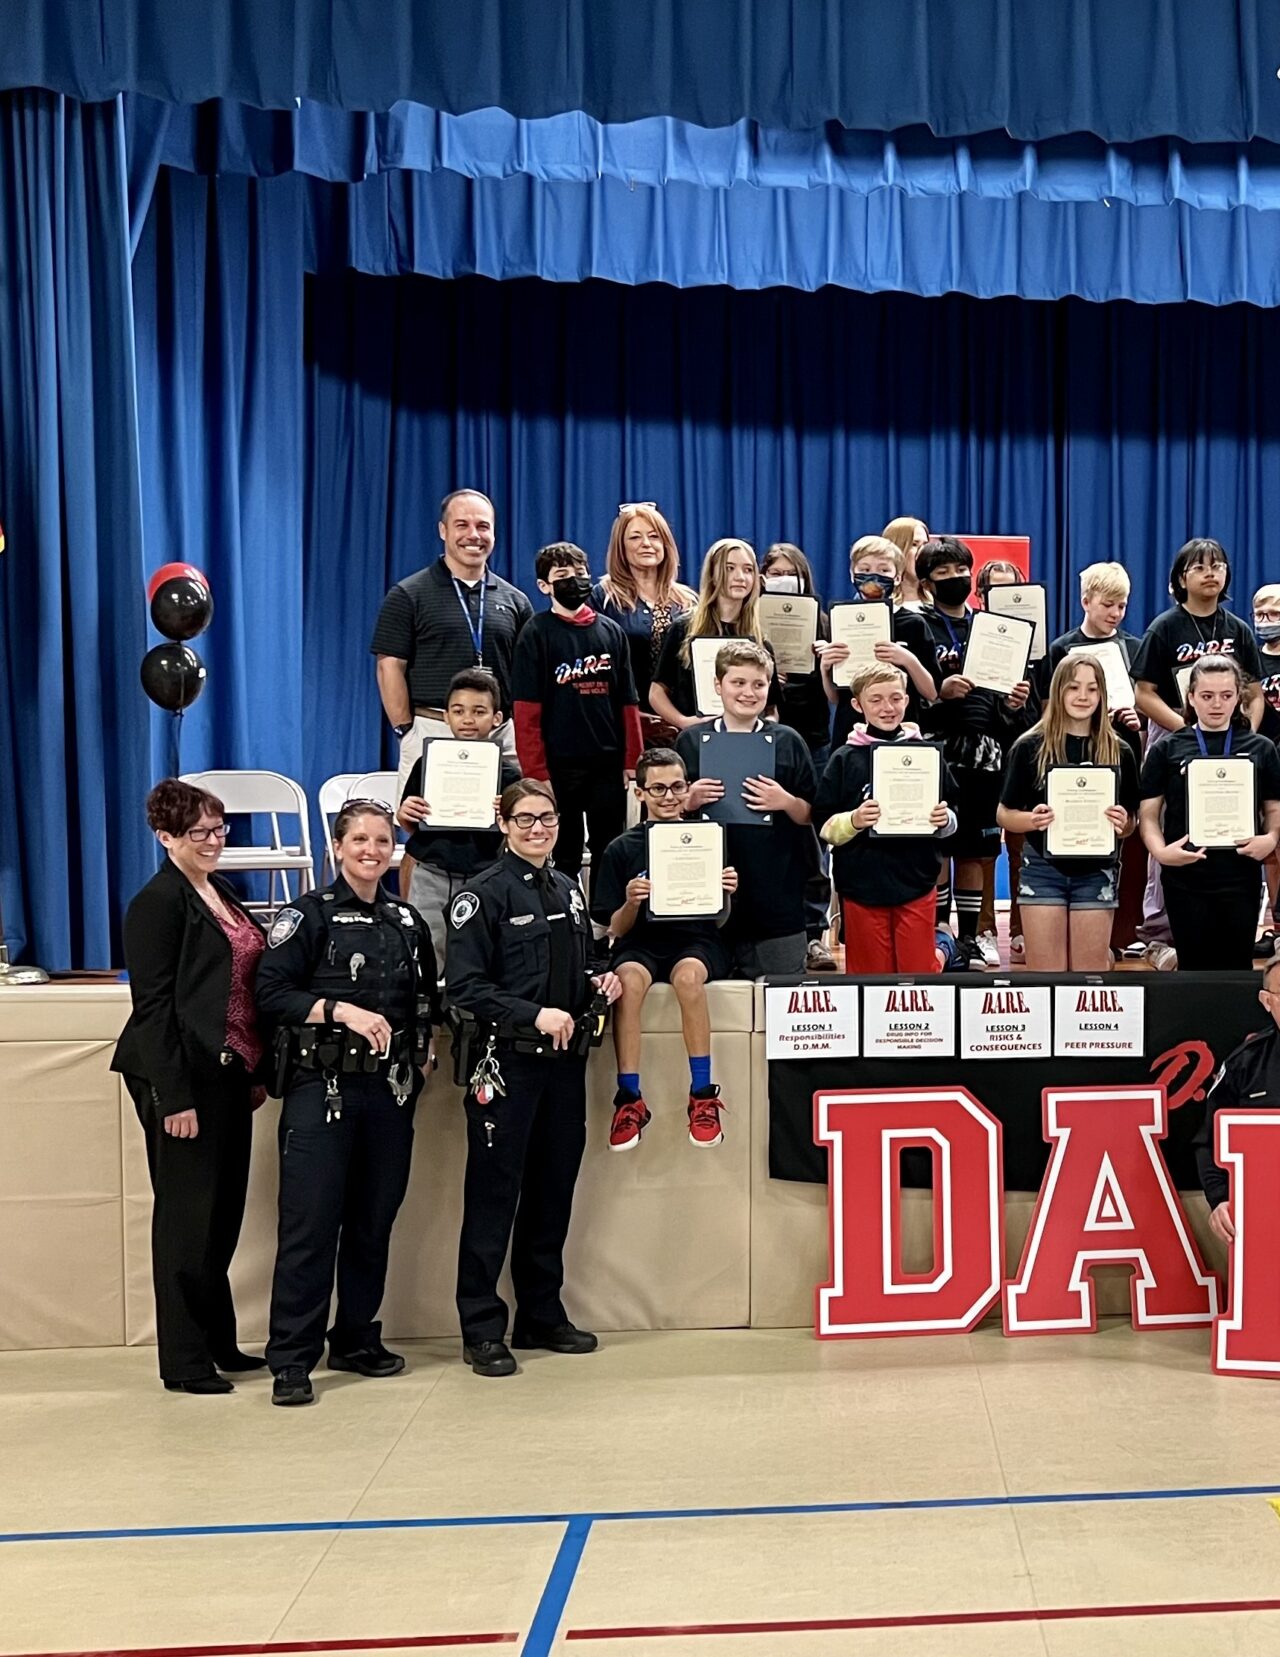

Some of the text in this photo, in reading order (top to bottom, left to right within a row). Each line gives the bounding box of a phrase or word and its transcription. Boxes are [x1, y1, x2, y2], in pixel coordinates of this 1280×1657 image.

[791, 1024, 827, 1032] LESSON
[889, 1023, 923, 1031] LESSON
[985, 1024, 1026, 1033] LESSON 3
[1079, 1023, 1112, 1031] LESSON
[779, 1033, 846, 1042] Responsibilities
[989, 1034, 1014, 1042] RISKS
[969, 1043, 1042, 1052] CONSEQUENCES
